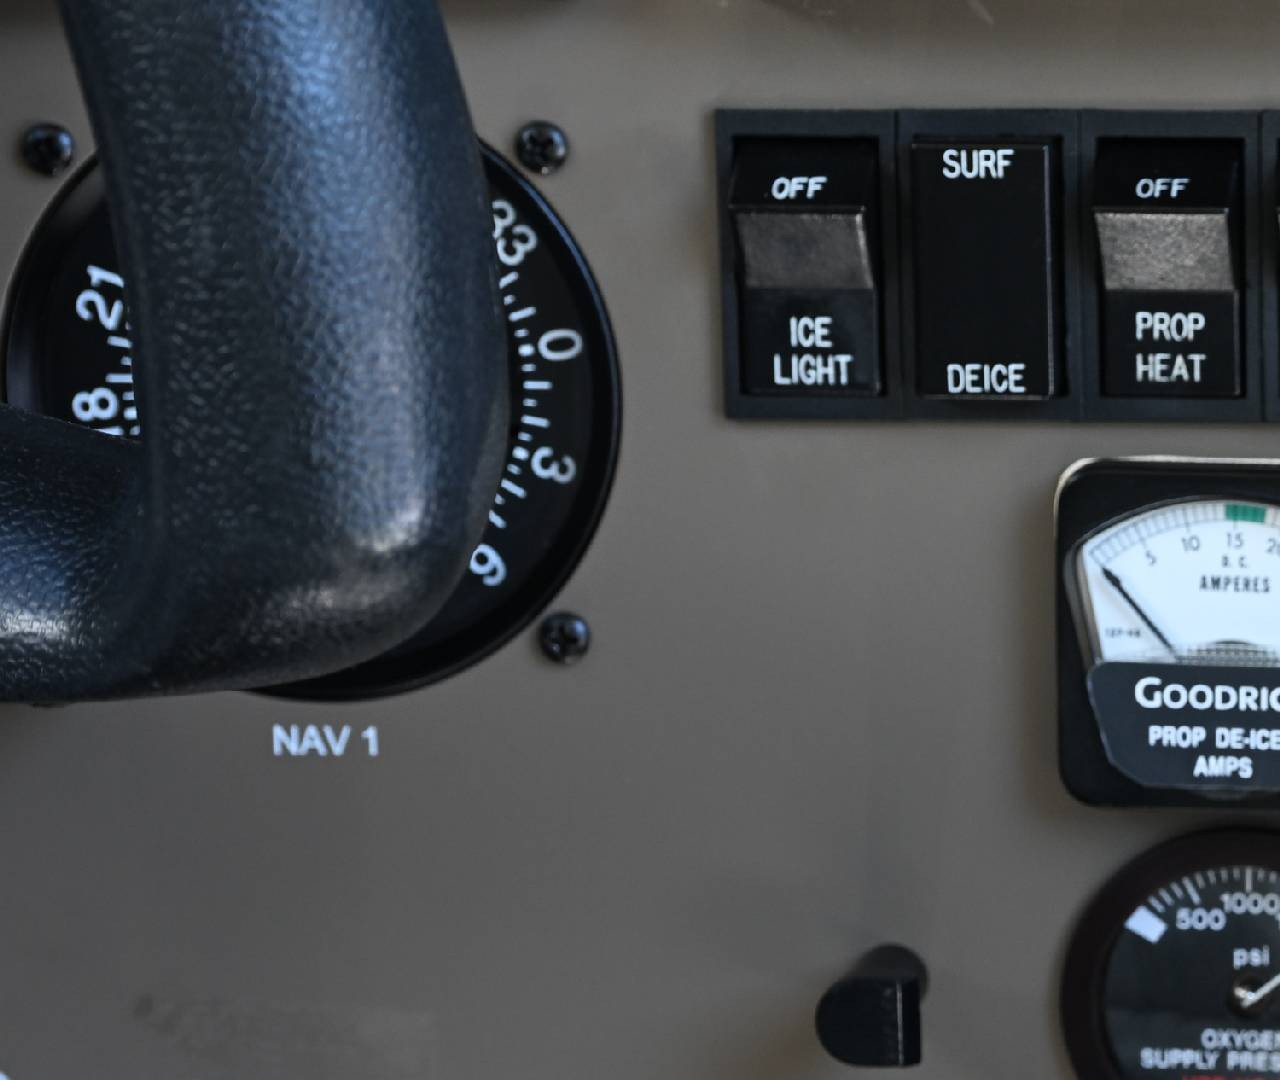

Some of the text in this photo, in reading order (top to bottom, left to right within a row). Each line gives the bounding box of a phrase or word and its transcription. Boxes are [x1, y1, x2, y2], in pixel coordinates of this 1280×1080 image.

[942, 149, 1014, 179] SURF
[772, 176, 827, 199] OFF
[1135, 178, 1189, 198] OFF
[75, 264, 124, 331] 21
[789, 316, 833, 348] ICE
[1135, 311, 1205, 341] PROP
[537, 328, 583, 361] 0
[773, 355, 852, 386] LIGHT
[947, 363, 1026, 393] DEICE
[1135, 353, 1206, 383] HEAT
[531, 446, 576, 484] 3
[1181, 536, 1200, 553] 10
[1227, 533, 1244, 548] 15
[1146, 551, 1157, 566] 5
[1200, 575, 1270, 593] AMPERES
[272, 724, 379, 756] NAV 1
[1148, 725, 1206, 749] PROP
[1193, 755, 1253, 779] AMPS
[1221, 893, 1280, 914] 1000
[1176, 908, 1226, 930] 500
[1232, 944, 1270, 969] psi
[1140, 1047, 1219, 1069] SUPPLY
